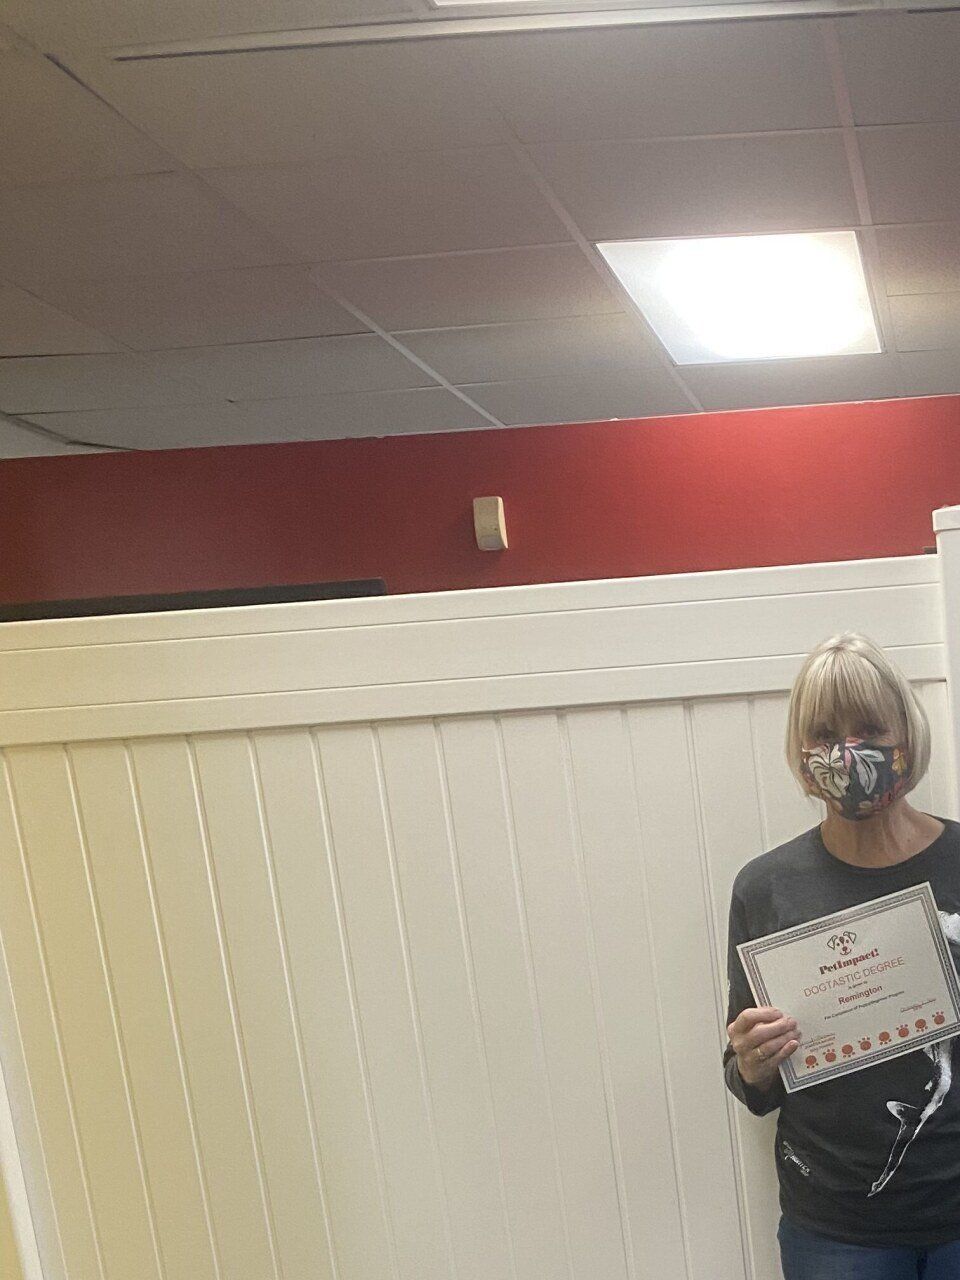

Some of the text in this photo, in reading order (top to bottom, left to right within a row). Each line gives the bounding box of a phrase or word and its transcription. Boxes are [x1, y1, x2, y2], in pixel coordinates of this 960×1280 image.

[819, 948, 880, 975] PetImpact!
[803, 956, 905, 998] DOGTASTIC DEGREE
[838, 985, 883, 1005] Remington
